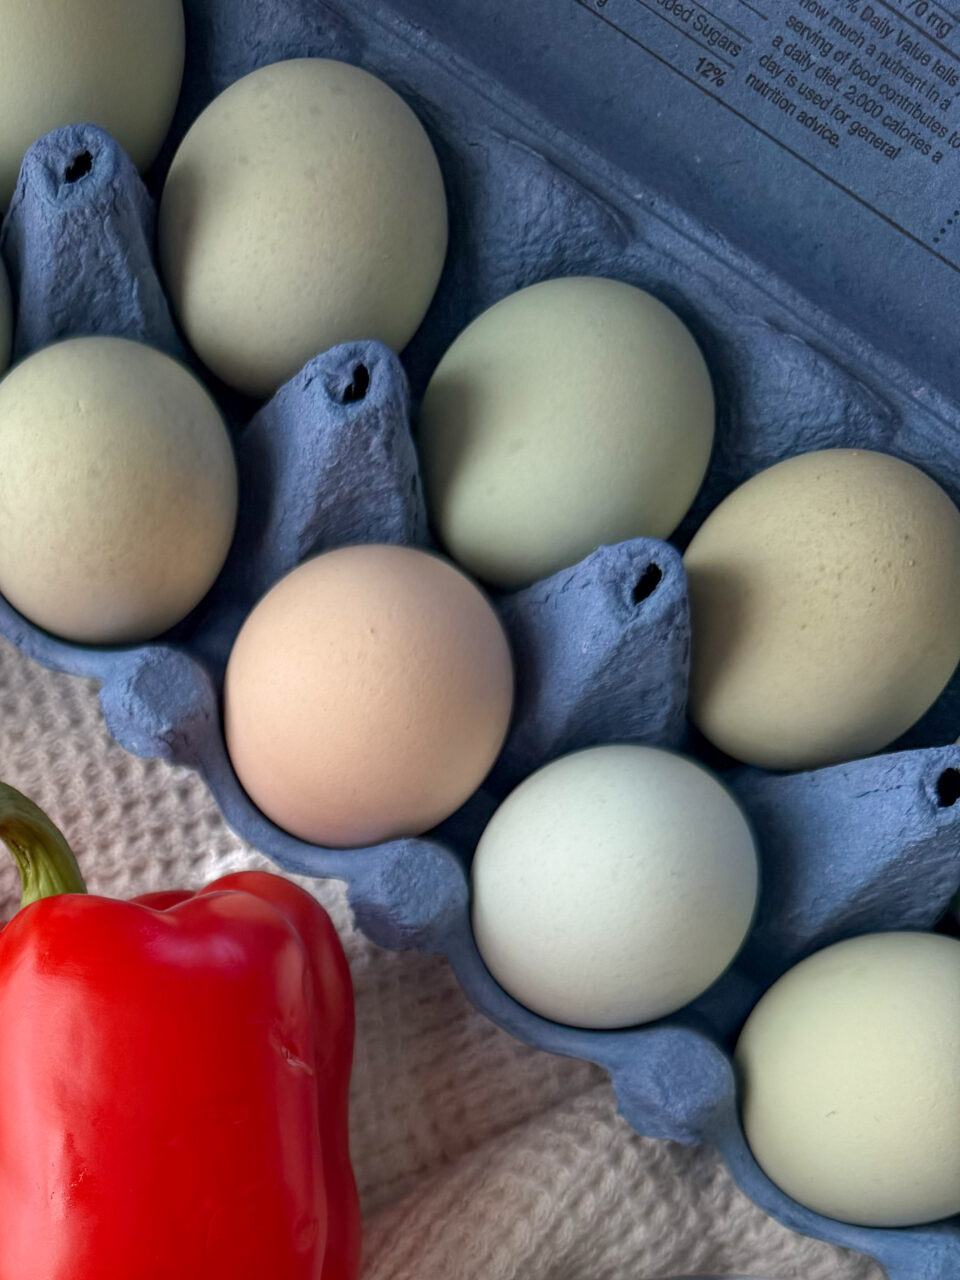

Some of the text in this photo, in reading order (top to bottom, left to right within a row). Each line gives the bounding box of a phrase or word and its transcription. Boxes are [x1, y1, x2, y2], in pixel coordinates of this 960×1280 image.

[693, 14, 741, 57] Sugars
[828, 16, 865, 48] much
[866, 44, 877, 57] a
[876, 51, 927, 93] nutrient
[925, 85, 940, 103] in
[940, 99, 951, 112] a
[860, 5, 894, 39] Daily
[896, 29, 931, 66] Value
[931, 59, 959, 87] tells
[926, 11, 953, 39] mg
[694, 57, 727, 87] 12%
[745, 73, 840, 148] nutrition advice.
[759, 54, 902, 160] day is used for general
[772, 35, 943, 164] a daily diet. 2,000 calories a
[785, 15, 960, 149] serving of food contributes to
